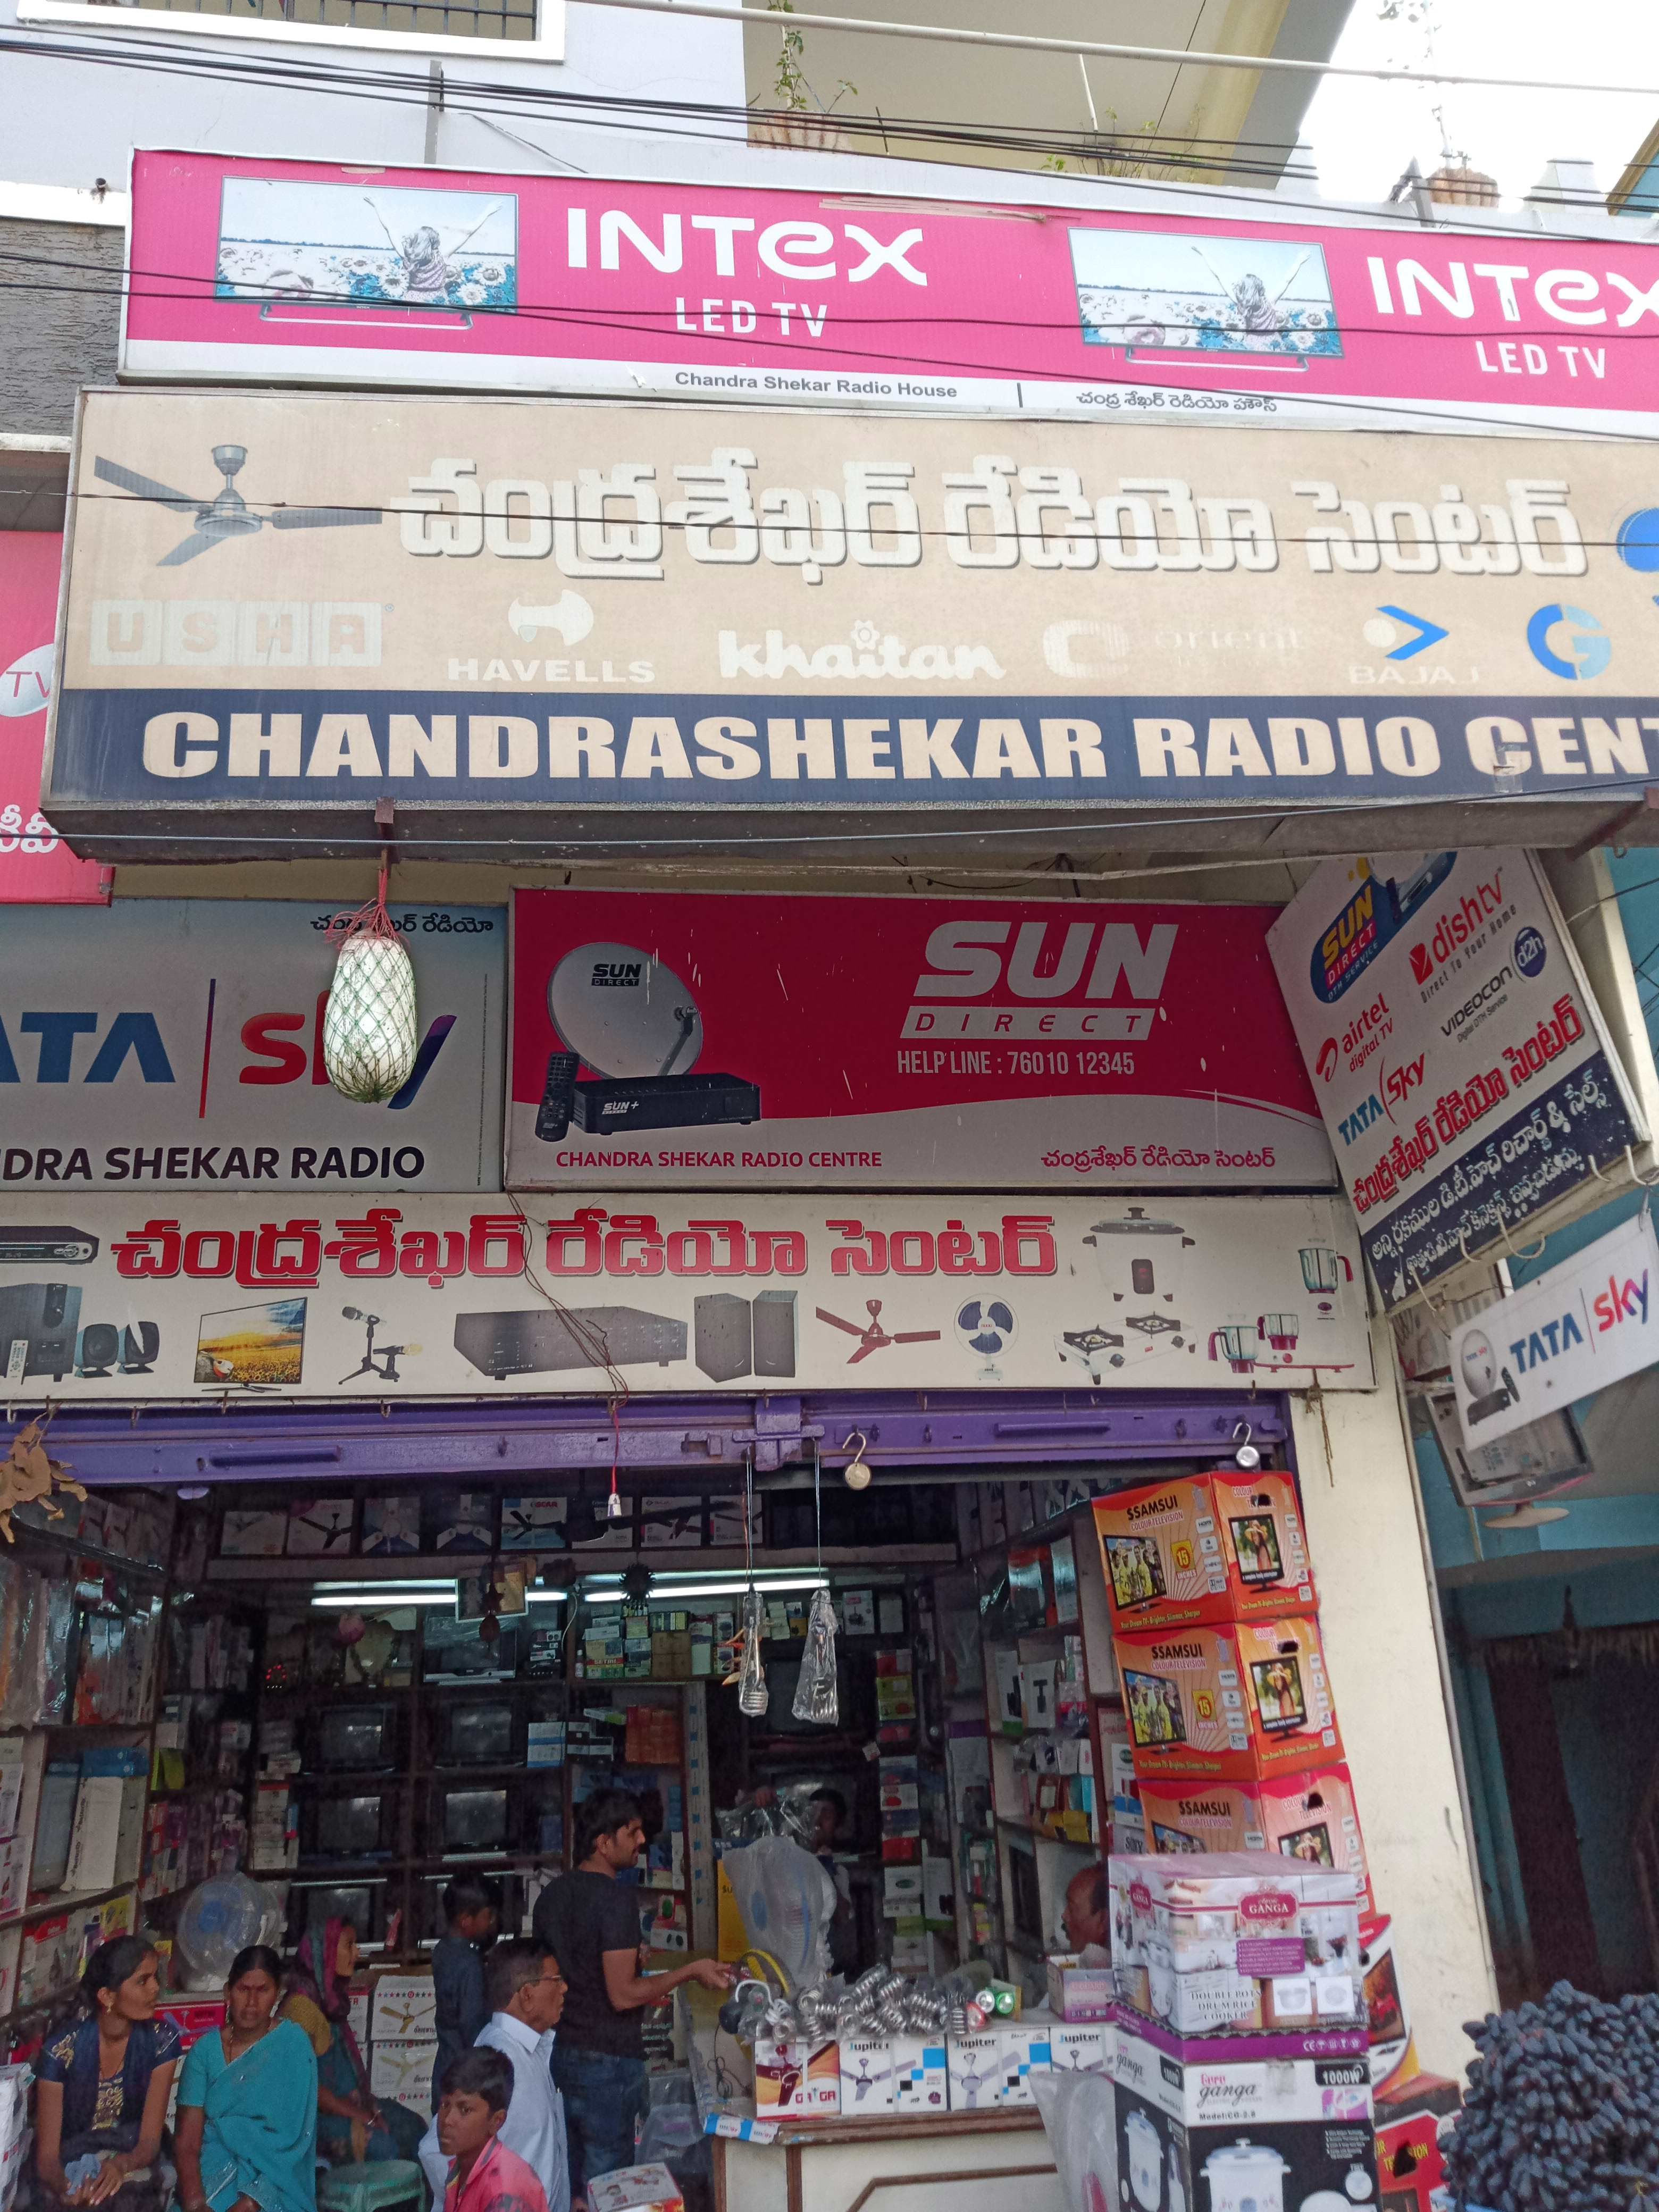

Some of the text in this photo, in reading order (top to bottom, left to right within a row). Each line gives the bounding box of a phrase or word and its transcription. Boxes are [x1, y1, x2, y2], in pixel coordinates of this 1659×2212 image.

[675, 297, 828, 337] LED TV
[1475, 340, 1605, 379] LED TV
[675, 372, 958, 398] Chandra Shekar Radio House
[1076, 391, 1121, 409] చంద్ర
[1124, 390, 1165, 410] శేఖర్
[942, 454, 1279, 574] రేడియో
[1291, 478, 1589, 578] సెంటర్
[96, 606, 378, 660] USHA
[719, 623, 1006, 681] khaitan
[448, 658, 656, 684] HAVELLS
[142, 711, 1108, 780] CHANDRASHEKAR
[1134, 716, 1441, 778] RADIO
[1322, 884, 1373, 970] SUN
[913, 920, 1179, 1000] SUN
[1327, 923, 1373, 985] DIRECT
[1420, 970, 1449, 1004] Direct
[1450, 958, 1462, 974] To
[1464, 933, 1487, 959] Your
[1517, 936, 1544, 968] d2h
[592, 963, 642, 978] SUN
[909, 1010, 1144, 1036] DIRECT
[1342, 992, 1390, 1054] airtel
[1350, 1017, 1393, 1073] digital TV
[897, 1050, 945, 1074] HELP
[950, 1051, 991, 1074] LINE
[1007, 1051, 1069, 1075] 76010
[1076, 1052, 1135, 1075] 12345
[1337, 1093, 1385, 1146] TATA
[0, 1145, 425, 1180] DRA SHEKAR RADIO
[556, 1151, 883, 1168] CHANDRA SHEKAR RADIO CENTRE
[1141, 1144, 1210, 1168] రేడియో
[545, 1208, 808, 1277] రేడియో
[825, 1215, 1059, 1277] సెంటర్
[1509, 1268, 1649, 1374] TATA sky
[1126, 1494, 1178, 1521] SSAMSUI
[1176, 1548, 1190, 1566] 15
[1152, 1643, 1203, 1660] SSAMSUI
[1178, 1799, 1231, 1816] SSAMSUI
[1249, 1903, 1289, 1914] GANGA
[1322, 2068, 1361, 2085] 1000W
[1196, 2084, 1256, 2108] ganga
